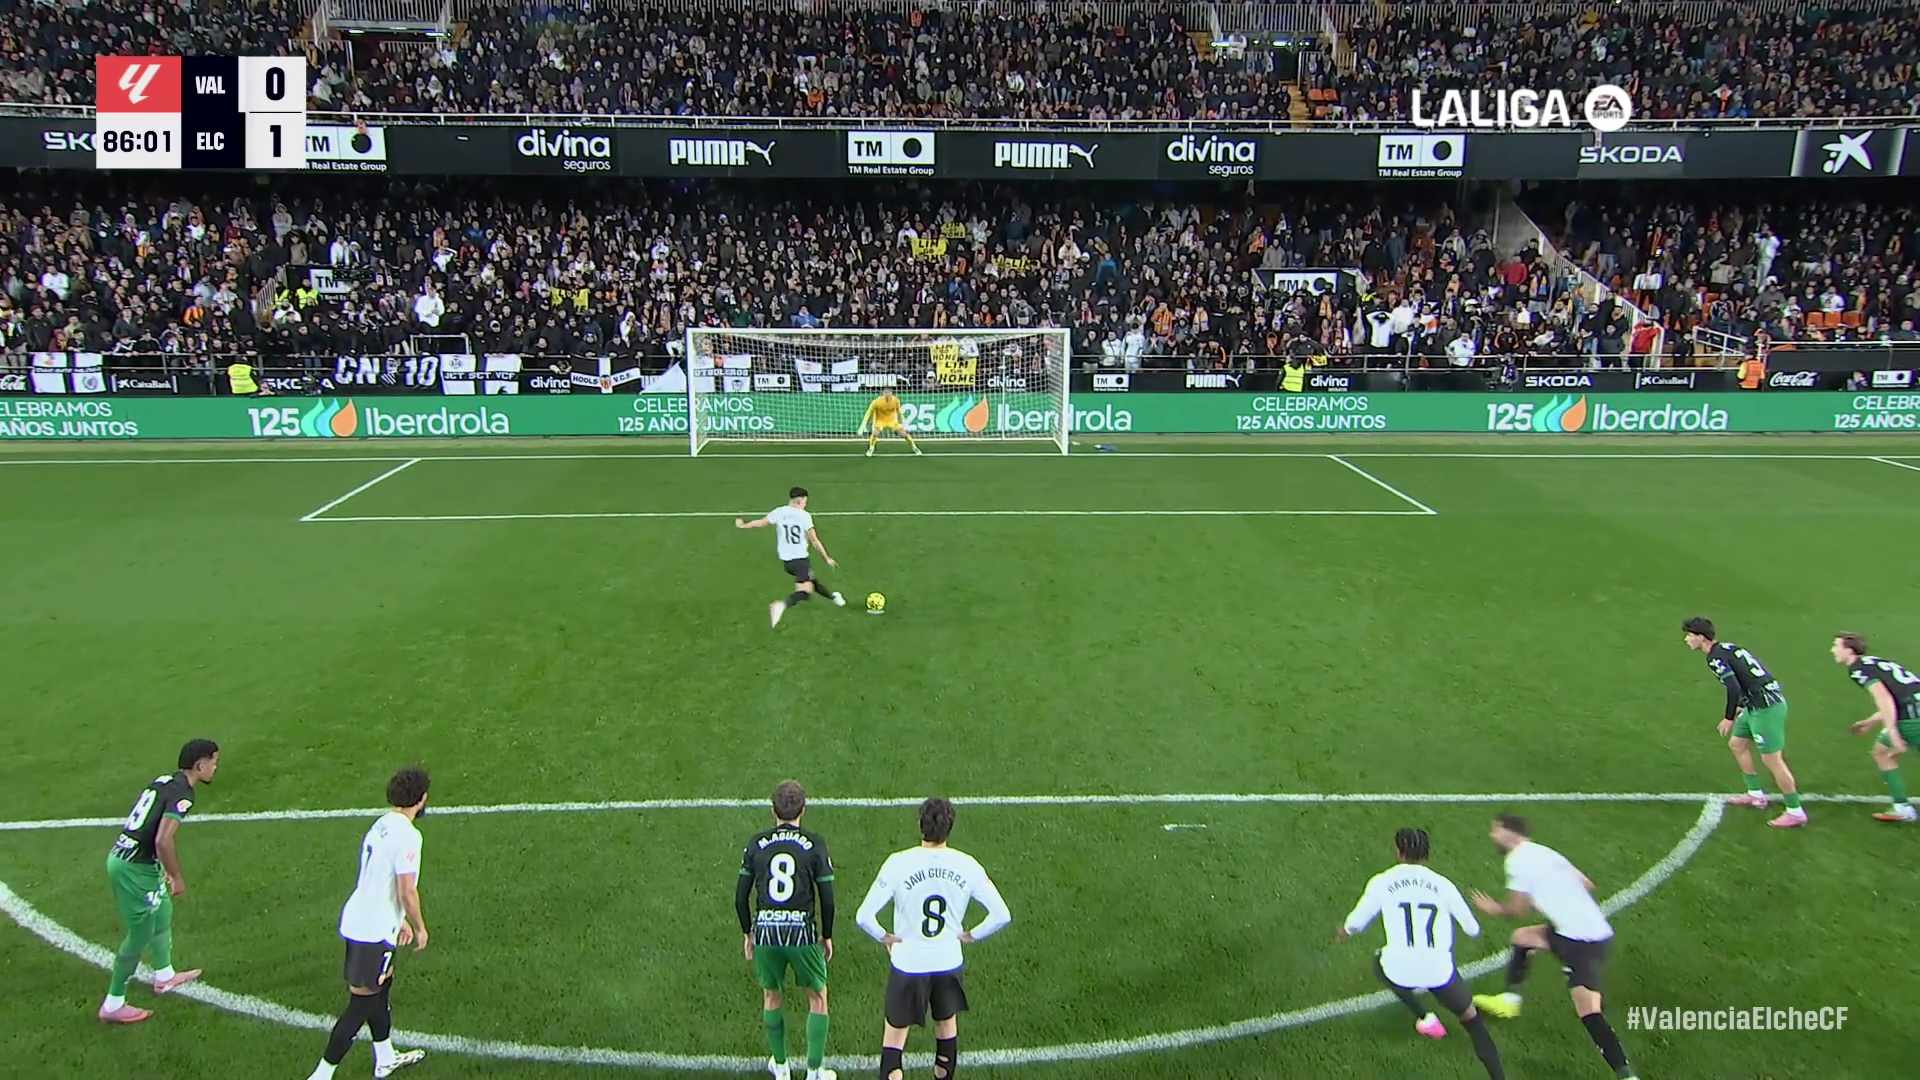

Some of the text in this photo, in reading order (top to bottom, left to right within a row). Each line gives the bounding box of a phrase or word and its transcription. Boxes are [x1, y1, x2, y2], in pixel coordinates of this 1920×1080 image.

[518, 128, 611, 157] divina
[854, 140, 883, 156] TM
[1167, 135, 1255, 162] divina
[669, 139, 747, 165] PUMA
[994, 142, 1070, 168] PUMA
[1386, 145, 1413, 160] TM
[332, 162, 358, 171] Estate
[360, 162, 387, 172] Group
[564, 159, 611, 173] seguros
[849, 166, 934, 176] TM Real Estate Group
[1208, 165, 1254, 177] seguros
[1378, 169, 1462, 179] TM Real Estate Group
[315, 276, 338, 288] TM
[129, 379, 172, 389] CaixaBank
[530, 376, 570, 389] divina
[940, 374, 975, 383] HOME
[987, 376, 1026, 388] divina
[1096, 377, 1108, 385] TM
[1186, 374, 1227, 388] PUMA
[1311, 375, 1348, 388] divina
[1652, 376, 1688, 386] CaixaBank
[1252, 396, 1368, 411] CELEBRAMOS
[248, 406, 510, 437] 125 Iberdrola
[618, 416, 645, 431] 125
[704, 415, 775, 431] JUNTOS
[1236, 412, 1386, 430] 125 AÑOS JUNTOS
[1487, 403, 1729, 431] 125 Iberdrola
[1834, 411, 1916, 428] 125 AÑOS
[58, 421, 139, 436] JUNTOS
[783, 524, 801, 544] 18
[768, 853, 796, 902] 8
[904, 868, 967, 890] JAVI GUERRA
[921, 894, 947, 938] 8
[1398, 902, 1438, 948] 17
